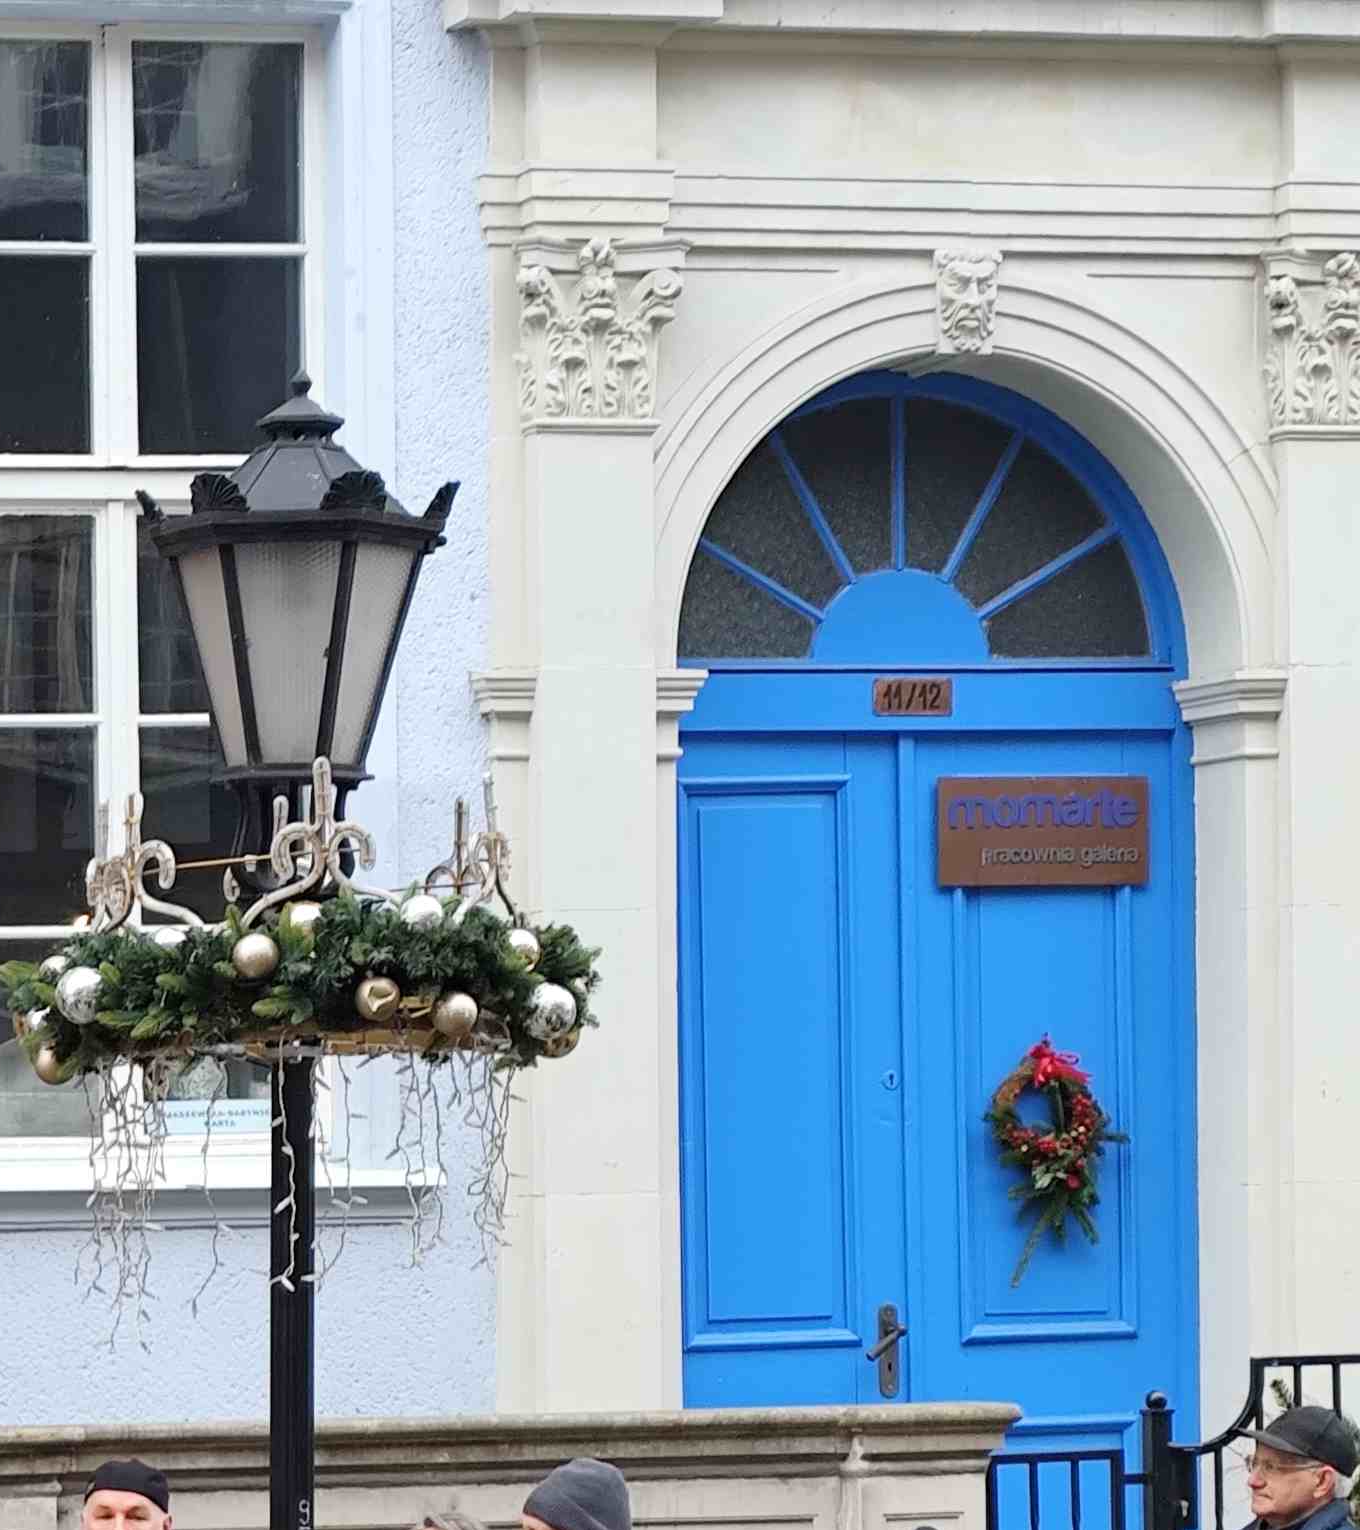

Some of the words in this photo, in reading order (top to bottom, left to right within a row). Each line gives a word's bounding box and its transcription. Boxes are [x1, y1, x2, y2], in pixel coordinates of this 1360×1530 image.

[883, 683, 941, 710] 11/12
[948, 789, 1138, 830] momarte
[981, 846, 1074, 866] pracownia
